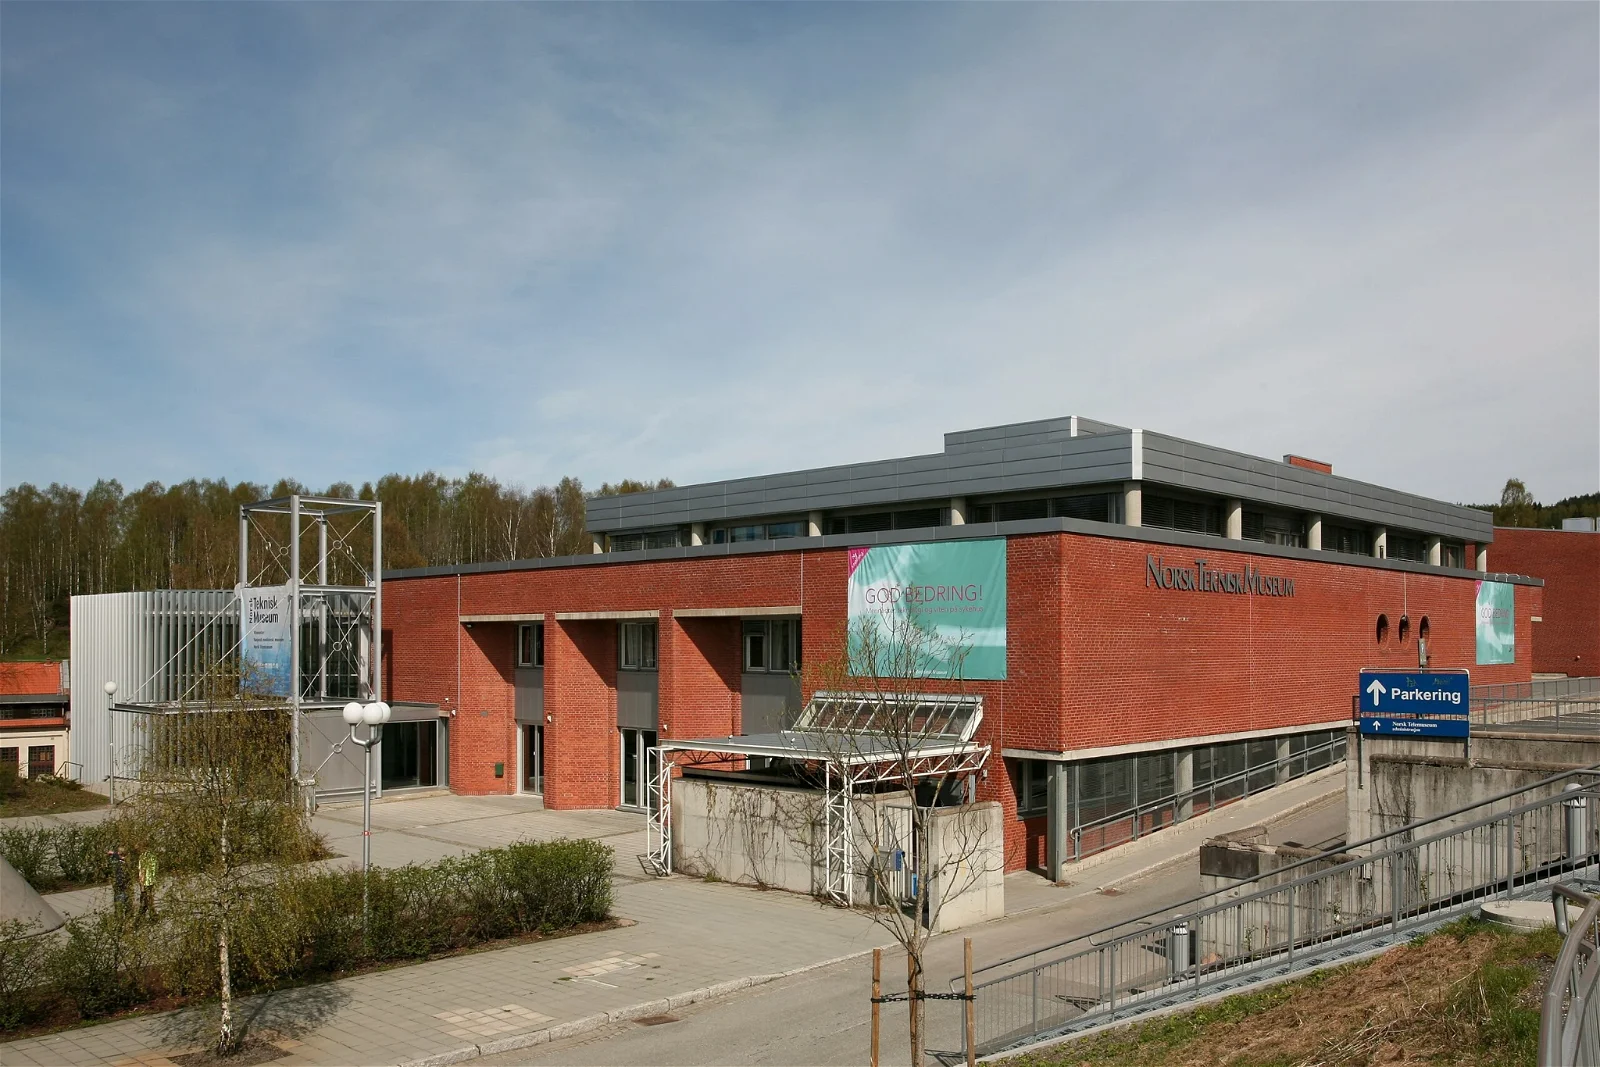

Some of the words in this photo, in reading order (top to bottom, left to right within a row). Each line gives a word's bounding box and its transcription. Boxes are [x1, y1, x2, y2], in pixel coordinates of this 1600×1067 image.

[1146, 554, 1195, 591] NORSK
[1195, 559, 1243, 594] TEKNISK
[1243, 564, 1295, 597] MUSEUM
[865, 587, 900, 604] GOD
[905, 584, 983, 603] BEDRING!
[253, 595, 278, 610] Teknisk
[924, 607, 932, 615] og
[949, 606, 957, 614] på
[958, 605, 983, 614] sykehus
[253, 611, 279, 623] Museum
[1391, 688, 1461, 705] Parkering
